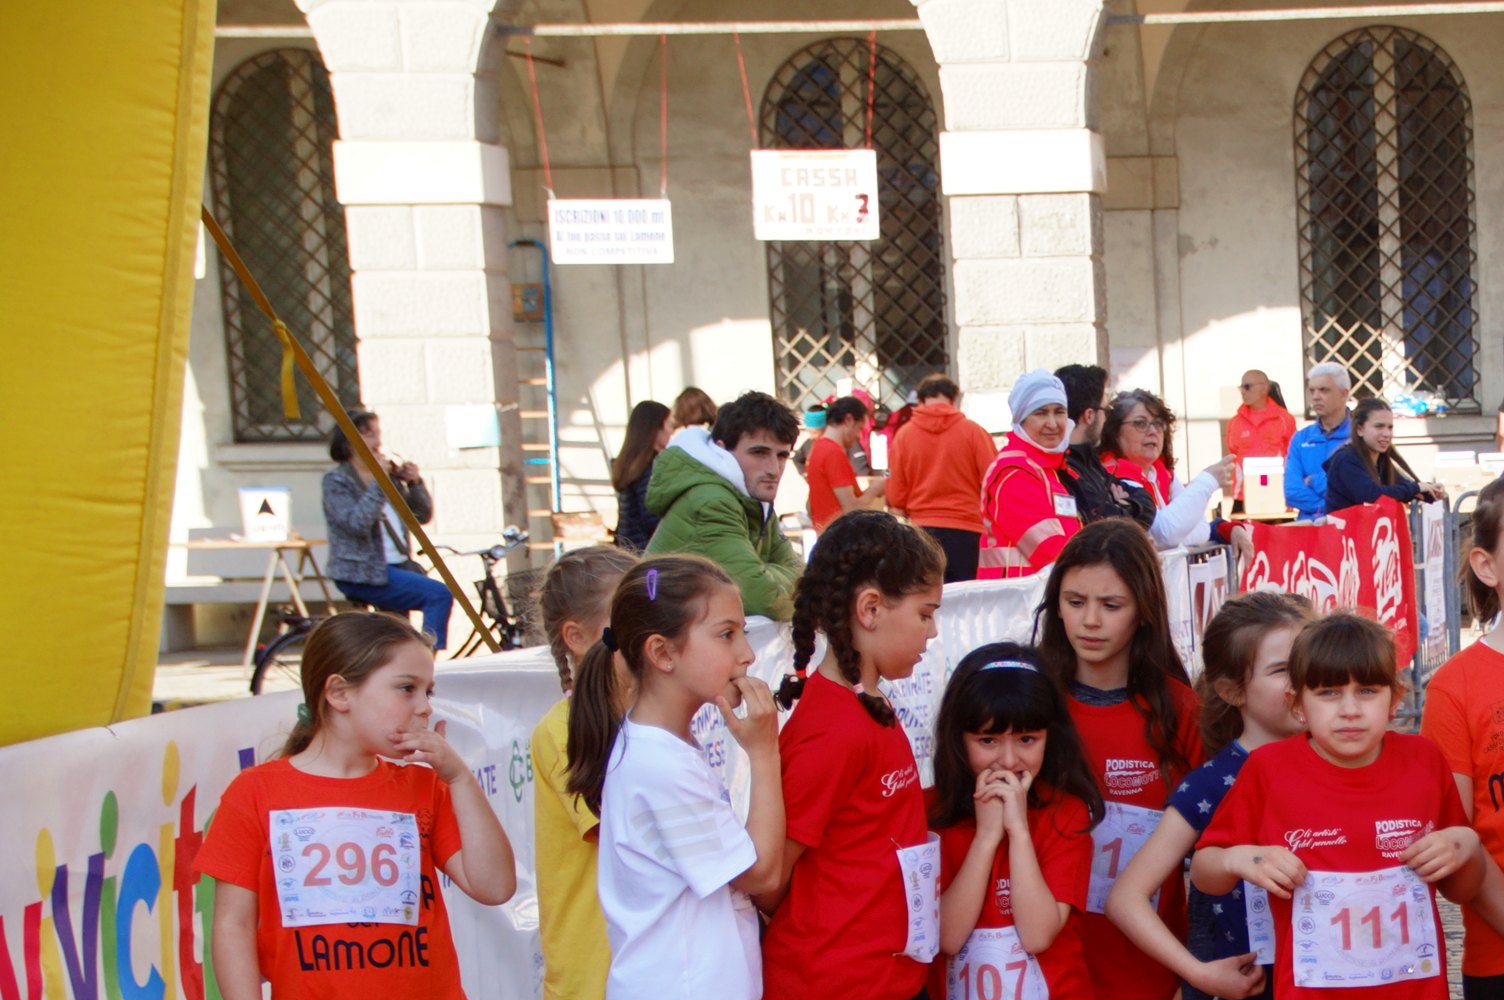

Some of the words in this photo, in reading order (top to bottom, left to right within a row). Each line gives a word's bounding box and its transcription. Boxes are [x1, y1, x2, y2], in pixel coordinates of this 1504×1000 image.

[780, 167, 858, 187] CASSA
[554, 209, 610, 225] ISCRIZIONI
[788, 192, 815, 224] 10
[631, 230, 666, 242] Lamone
[1105, 759, 1156, 772] PODISTICA
[1109, 787, 1143, 796] RAVENNA
[1375, 819, 1423, 835] PODISTICA
[301, 841, 400, 888] 296
[1329, 901, 1411, 951] 111
[294, 926, 431, 972] LAMONE
